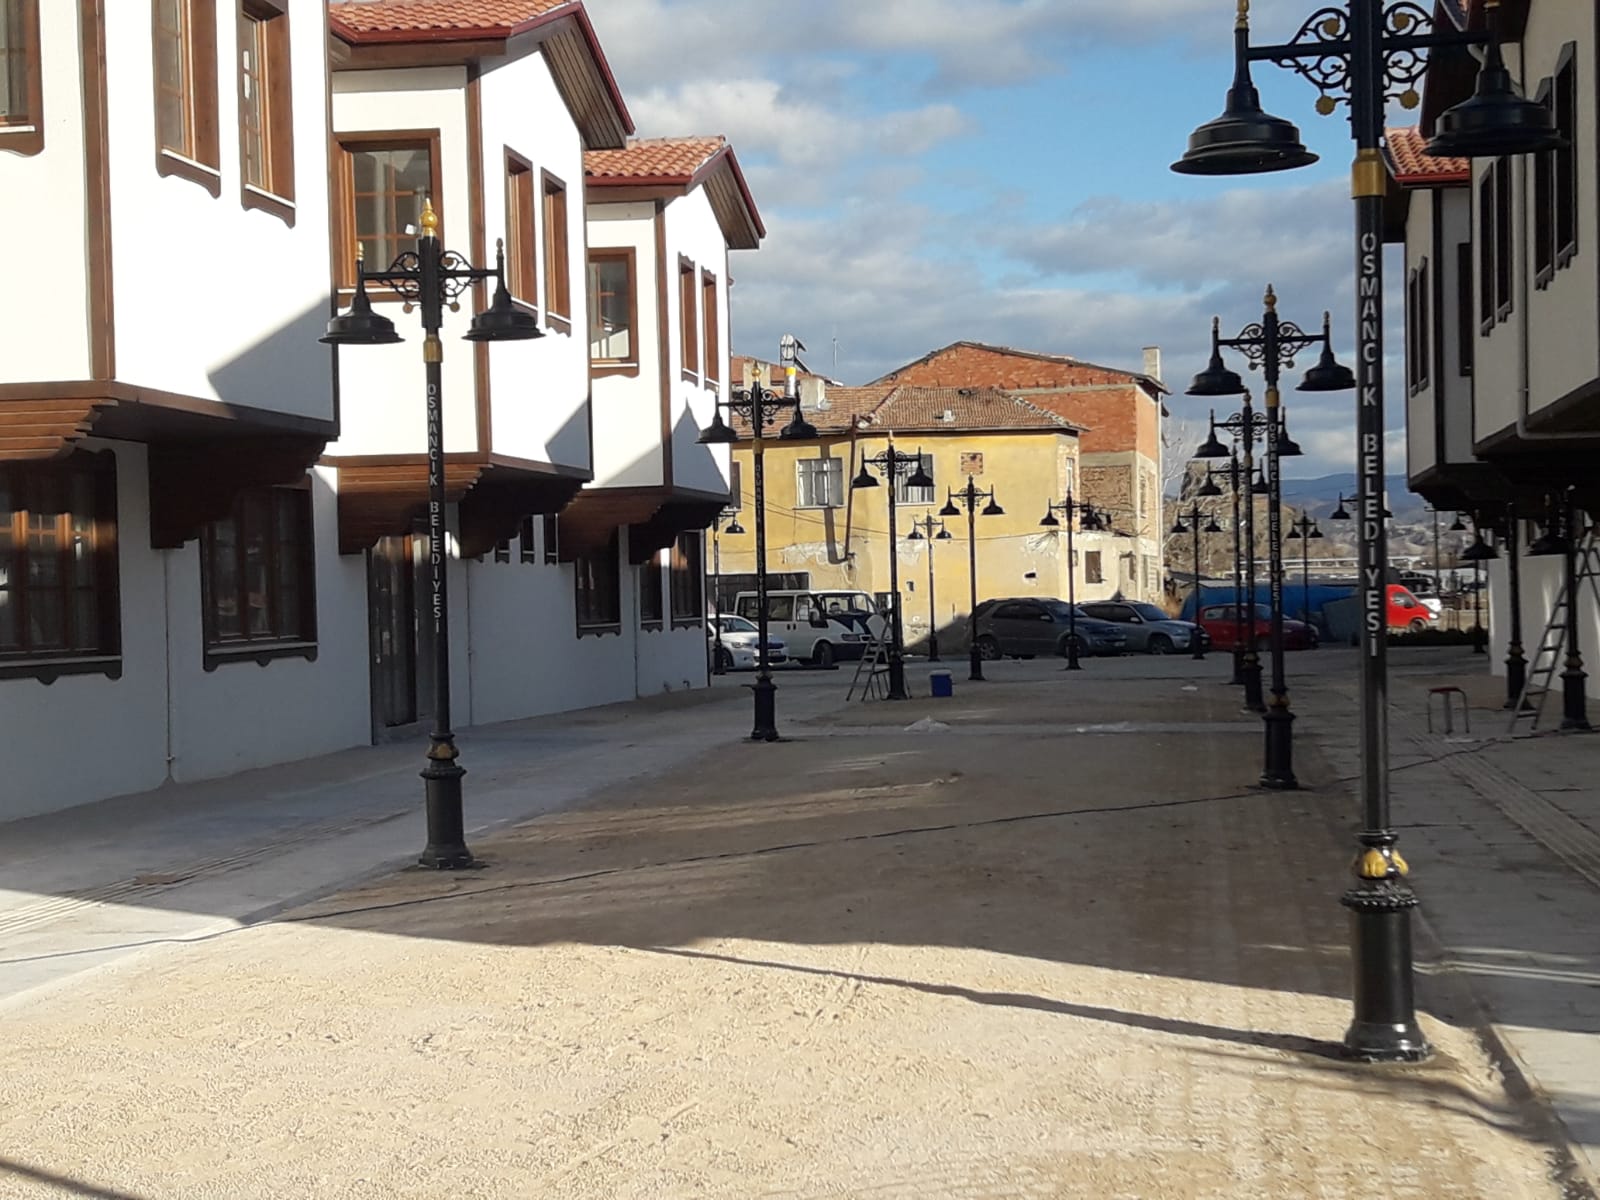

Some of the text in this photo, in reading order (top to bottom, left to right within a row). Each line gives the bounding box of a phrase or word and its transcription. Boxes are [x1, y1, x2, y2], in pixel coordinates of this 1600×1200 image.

[427, 384, 439, 486] OSMANCIK
[1268, 423, 1278, 500] OSMANCIK
[1360, 232, 1380, 657] OSMANCIK BELEDİYESİ
